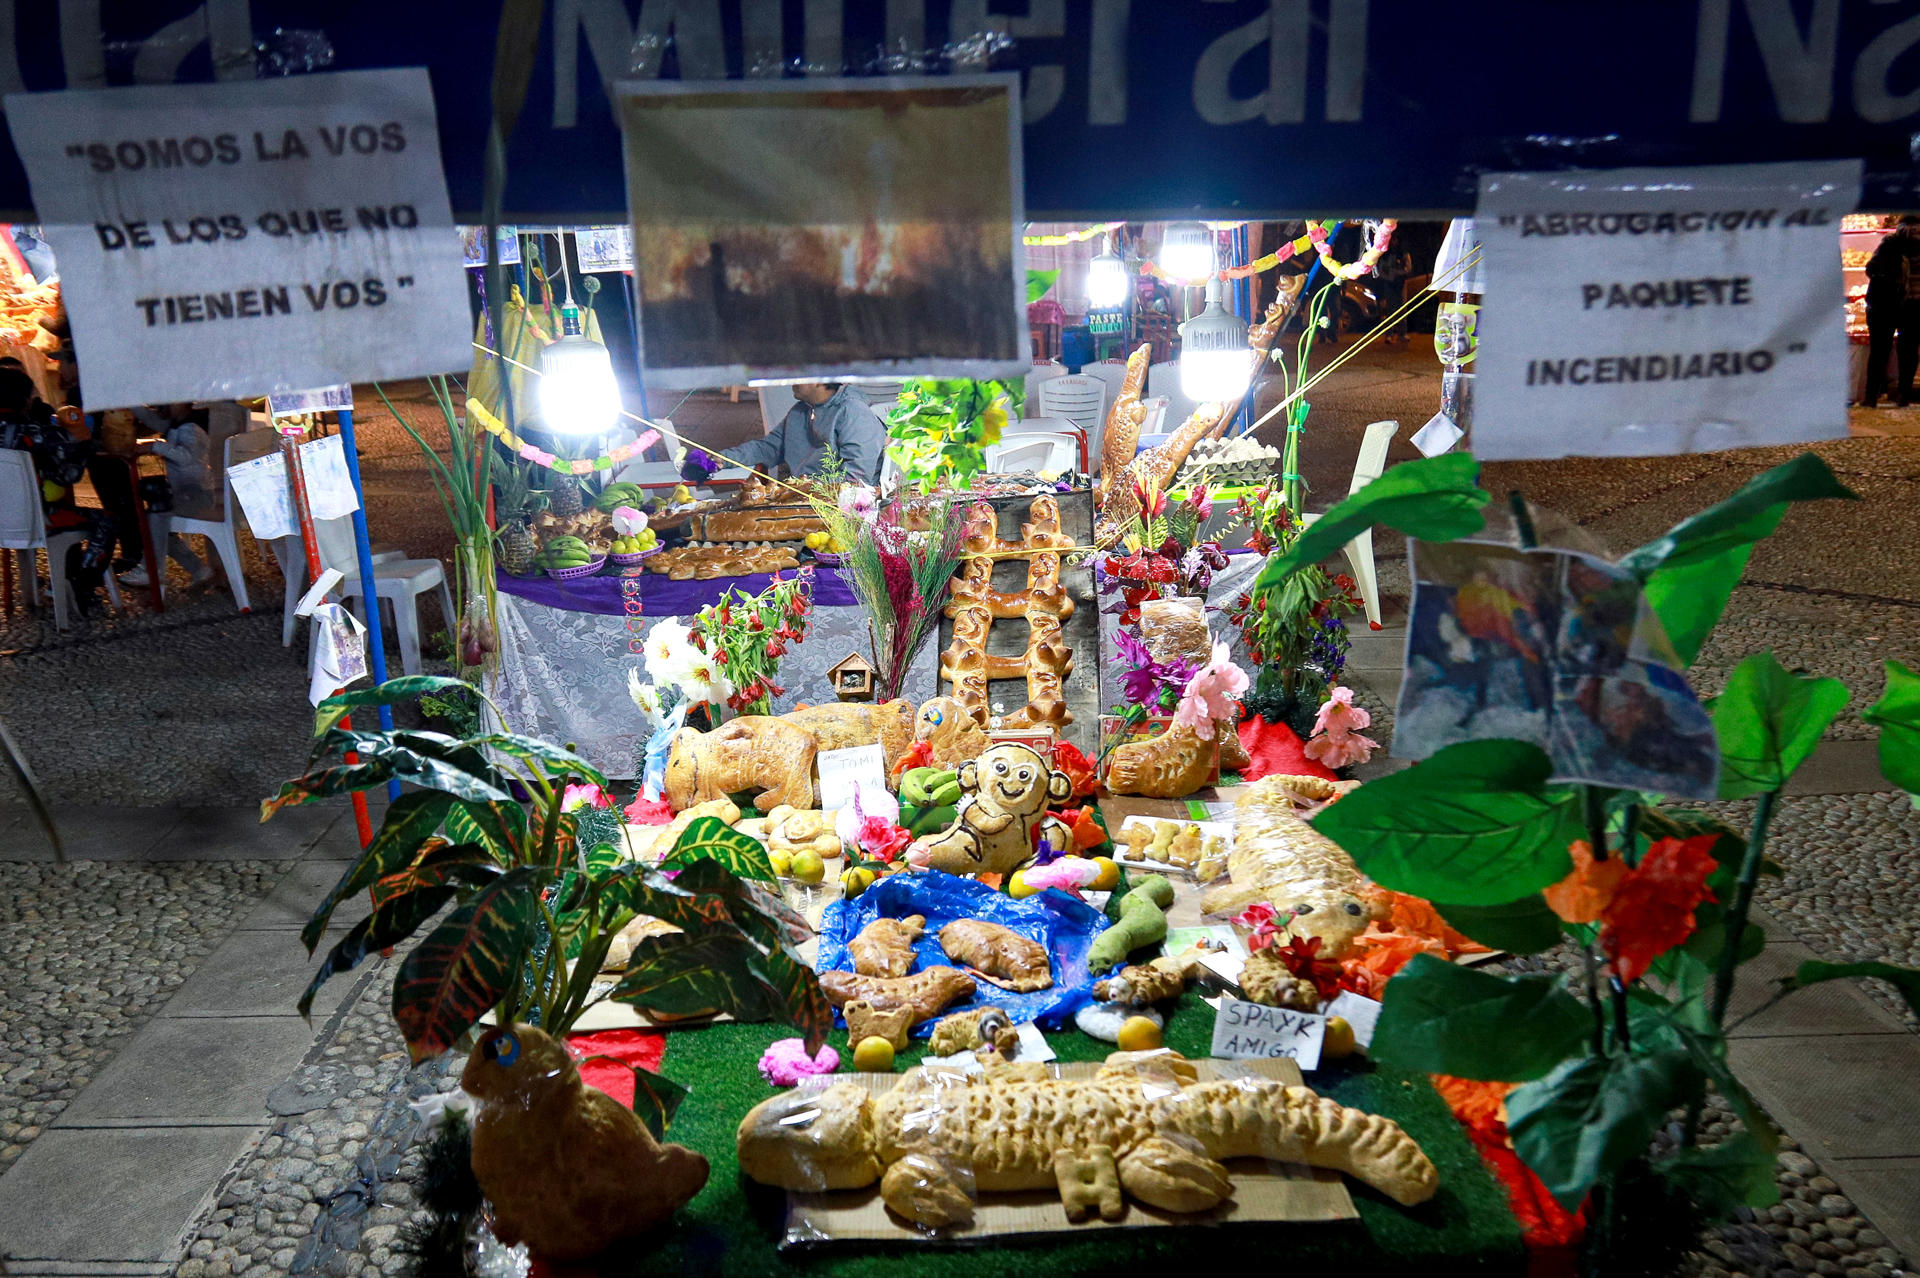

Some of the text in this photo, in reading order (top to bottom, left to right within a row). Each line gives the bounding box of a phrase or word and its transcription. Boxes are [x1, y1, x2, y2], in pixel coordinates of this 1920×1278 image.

[65, 121, 408, 174] "SOMOS LA VOS
[96, 204, 418, 252] DE LOS QUE NO
[1784, 207, 1831, 230] AL
[135, 285, 291, 327] TIENEN
[303, 279, 388, 312] VOS
[1581, 277, 1751, 311] PAQUETE
[1525, 350, 1775, 387] INCENDIARIO
[1225, 1004, 1315, 1037] SPAYK
